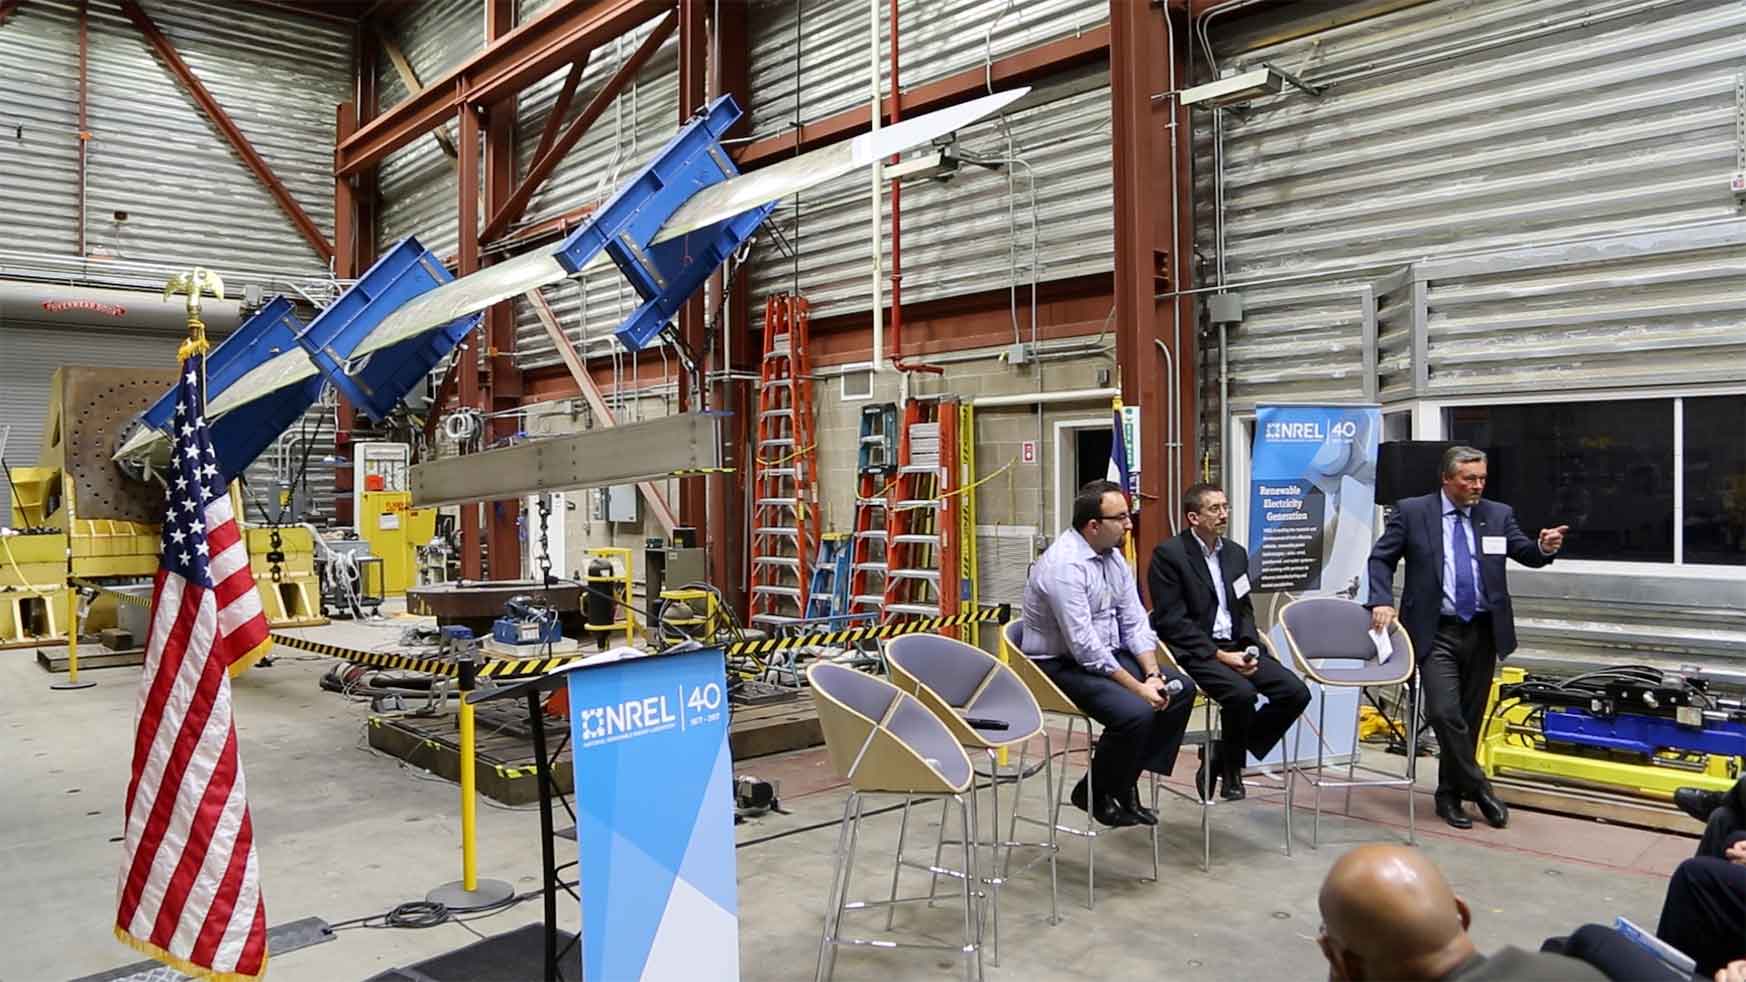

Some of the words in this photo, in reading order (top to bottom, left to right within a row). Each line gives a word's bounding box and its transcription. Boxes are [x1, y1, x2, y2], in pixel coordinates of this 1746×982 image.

[1281, 423, 1324, 438] NREL
[1331, 421, 1356, 437] 40
[1259, 486, 1301, 496] Renewable
[1263, 499, 1303, 509] Electricity
[1266, 512, 1308, 521] Generation
[605, 695, 676, 734] NREL
[688, 683, 721, 712] 40
